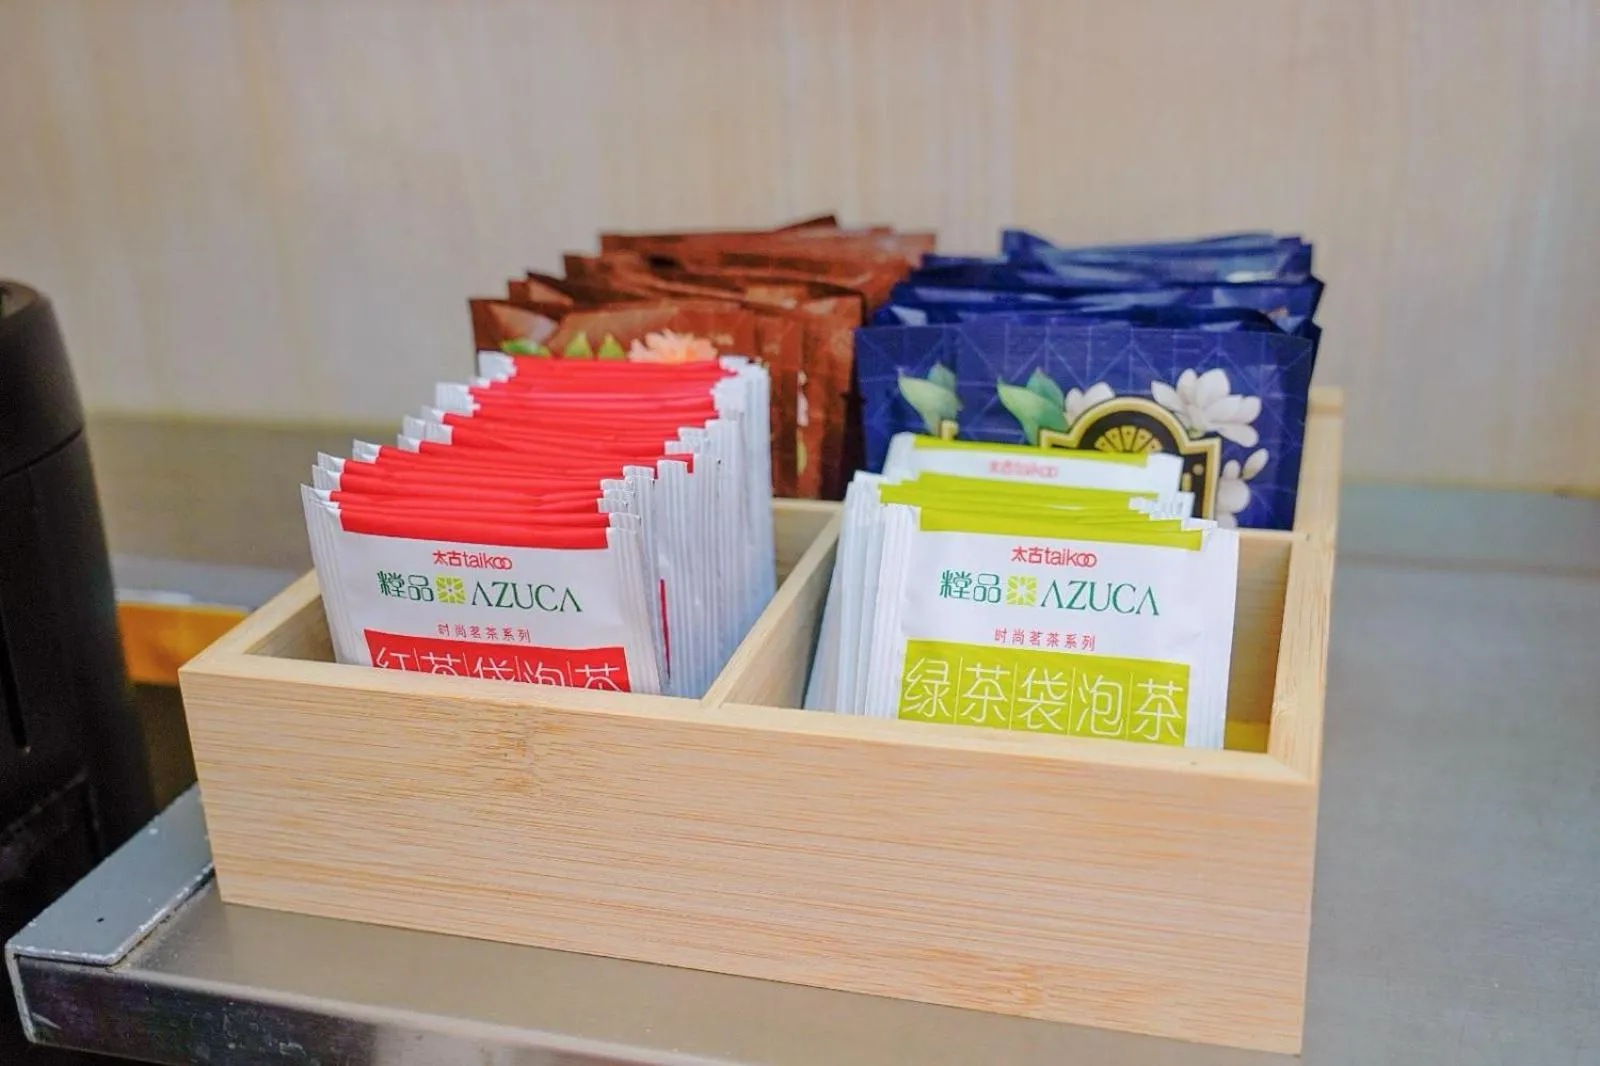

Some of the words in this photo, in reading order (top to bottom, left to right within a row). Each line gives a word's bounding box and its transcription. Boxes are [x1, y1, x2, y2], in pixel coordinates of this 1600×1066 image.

[471, 581, 583, 613] AZUCA
[1040, 579, 1160, 616] AZUCA
[994, 628, 1096, 652] 时尚茗茶系列
[902, 656, 1185, 741] 绿茶袋泡茶
